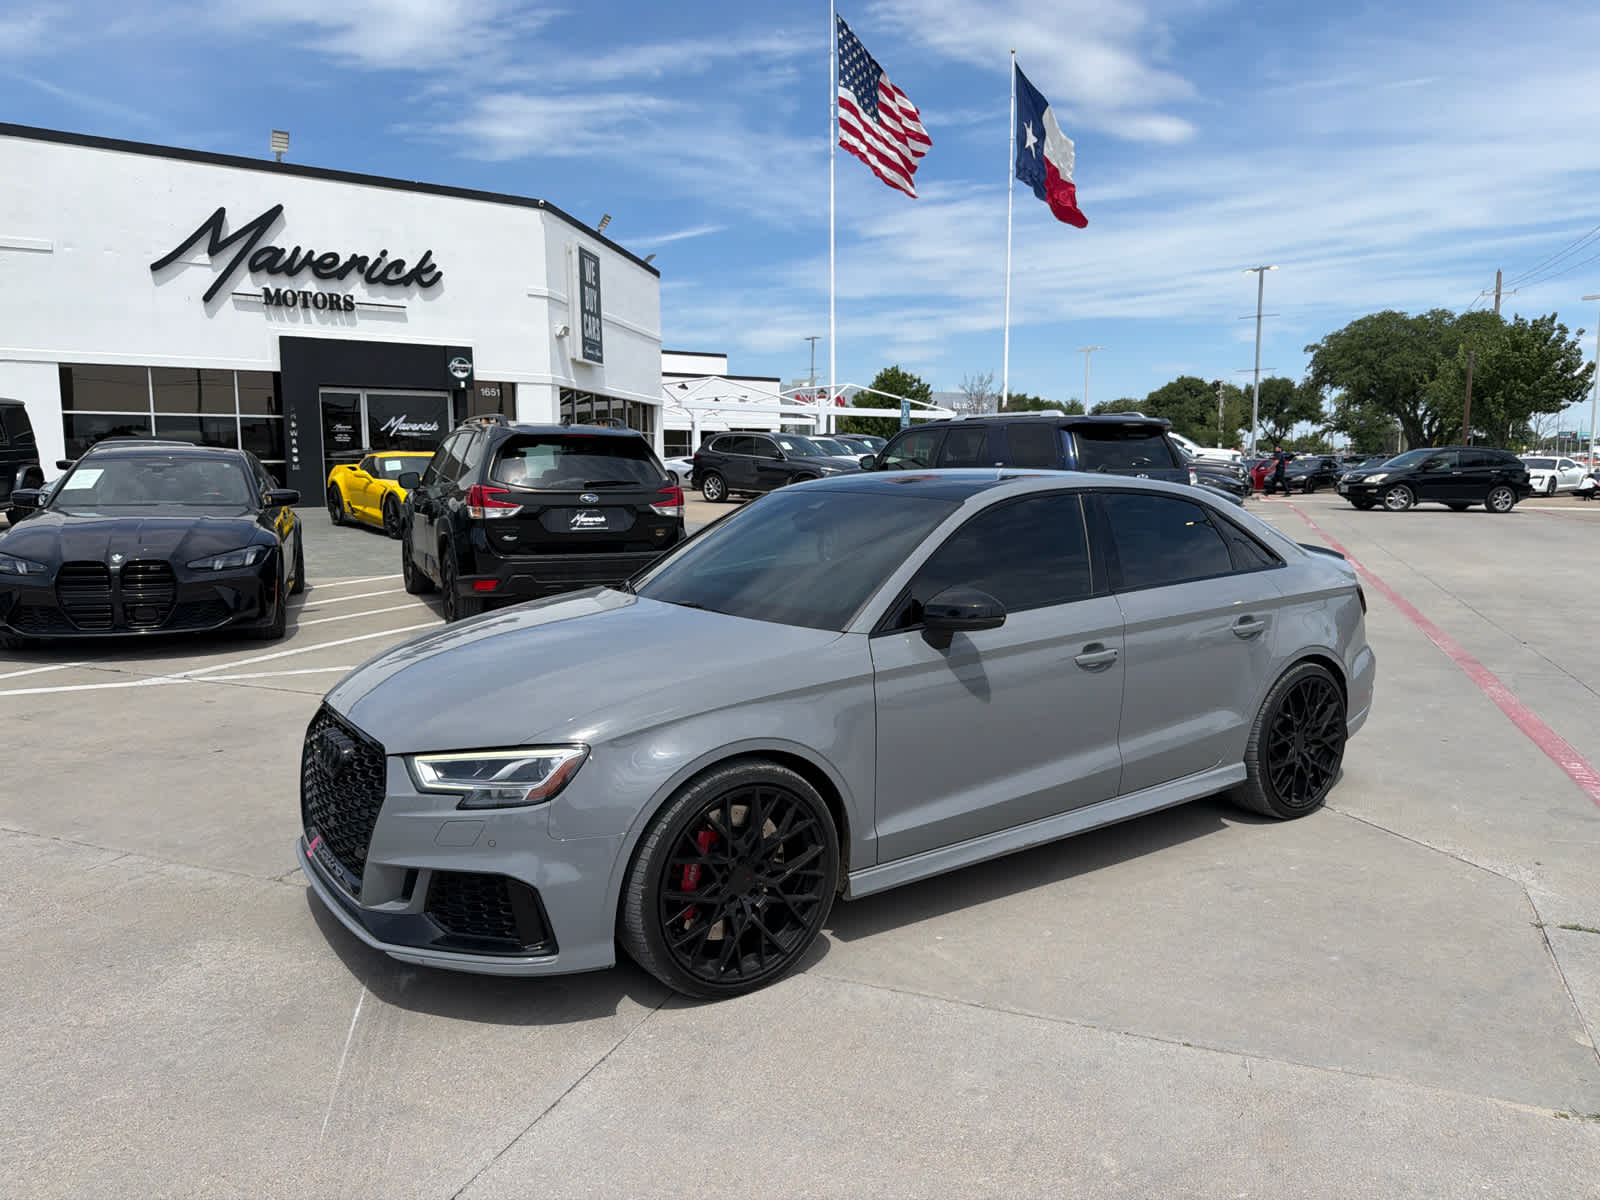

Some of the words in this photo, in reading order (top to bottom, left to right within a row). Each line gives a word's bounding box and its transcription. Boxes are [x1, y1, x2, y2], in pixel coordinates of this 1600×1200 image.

[150, 203, 443, 303] Maverick
[584, 257, 596, 286] WE
[262, 287, 356, 312] MOTORS
[584, 286, 598, 314] BUY
[583, 312, 601, 342] CARS
[480, 387, 501, 397] 1651
[380, 414, 439, 437] Maverick
